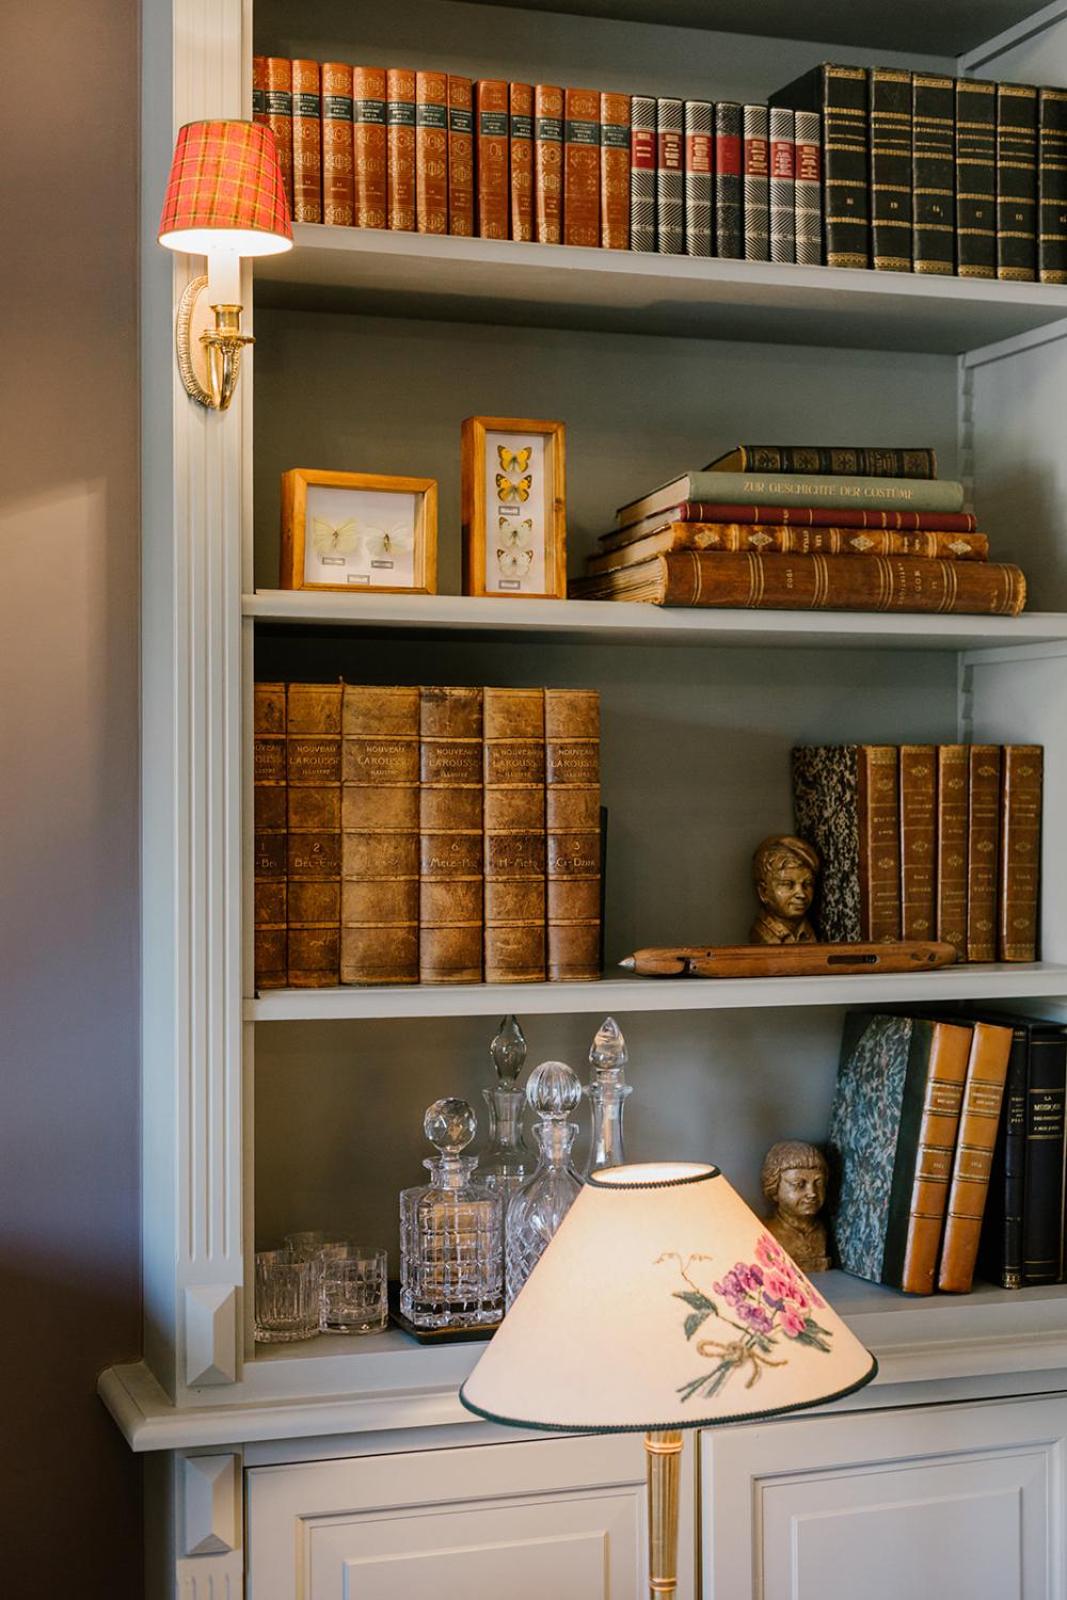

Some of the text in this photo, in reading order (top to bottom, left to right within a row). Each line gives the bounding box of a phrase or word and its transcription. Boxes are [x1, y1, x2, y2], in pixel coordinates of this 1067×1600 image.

[743, 481, 765, 492] ZUR
[768, 482, 834, 496] GESCHICHTE
[840, 485, 860, 497] DER
[491, 759, 542, 768] LAROUSS
[313, 842, 321, 853] 2
